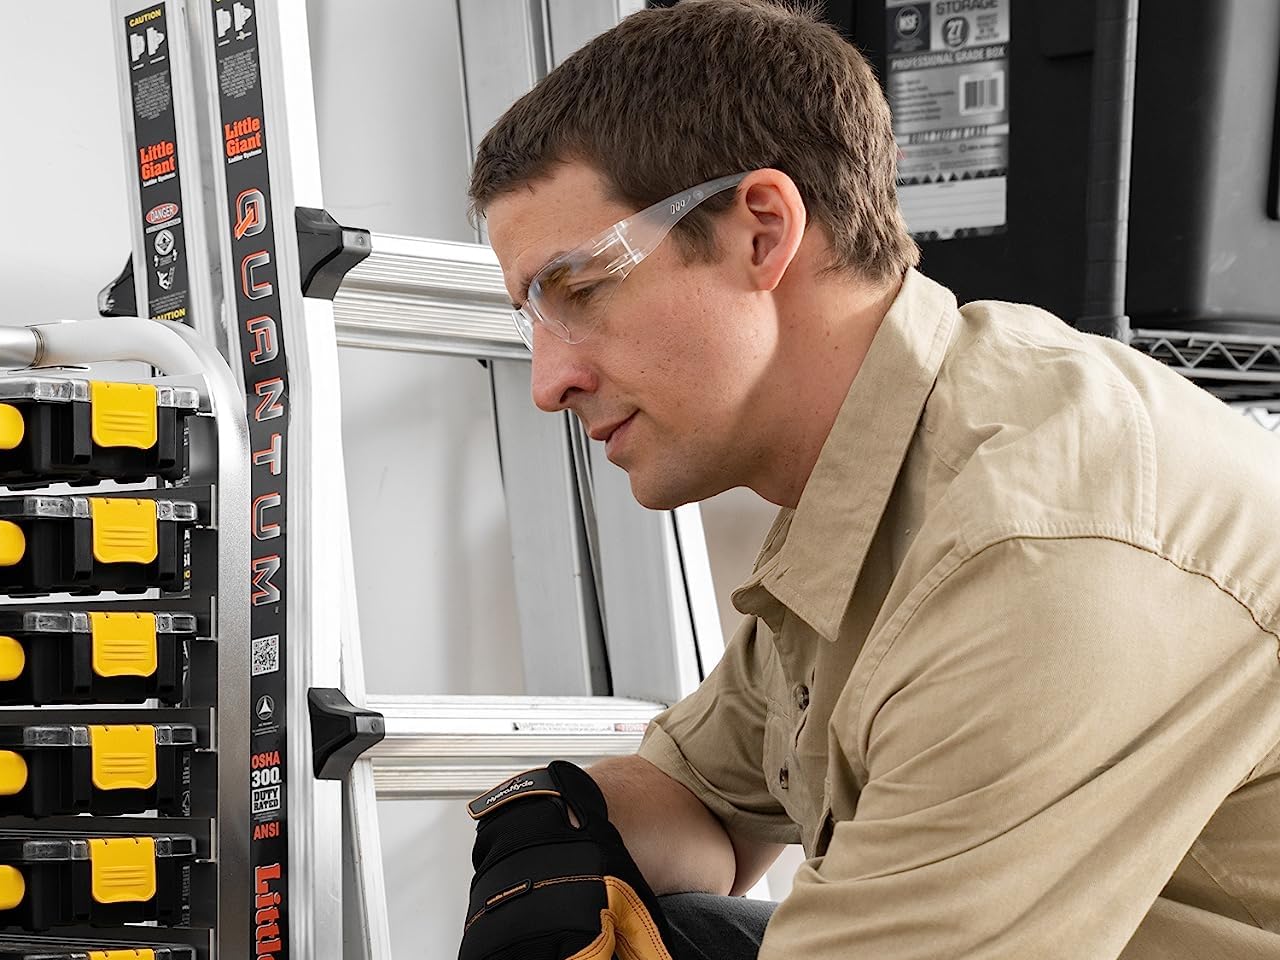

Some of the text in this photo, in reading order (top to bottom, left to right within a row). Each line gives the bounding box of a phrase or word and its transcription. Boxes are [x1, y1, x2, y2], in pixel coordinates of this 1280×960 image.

[129, 9, 162, 27] CAUTION
[892, 53, 955, 69] PROFESSIONAL
[985, 45, 1006, 59] BOX
[225, 117, 260, 140] Little
[140, 141, 174, 164] Little
[226, 133, 261, 157] Giant
[141, 157, 175, 181] Giant
[150, 205, 175, 222] DANGER
[152, 308, 186, 321] AUTION
[234, 188, 285, 607] QUANTUM
[251, 751, 281, 769] OSHA
[252, 767, 280, 788] 300
[253, 788, 279, 802] DUTY
[253, 799, 279, 811] RATED
[253, 822, 280, 840] ANSI
